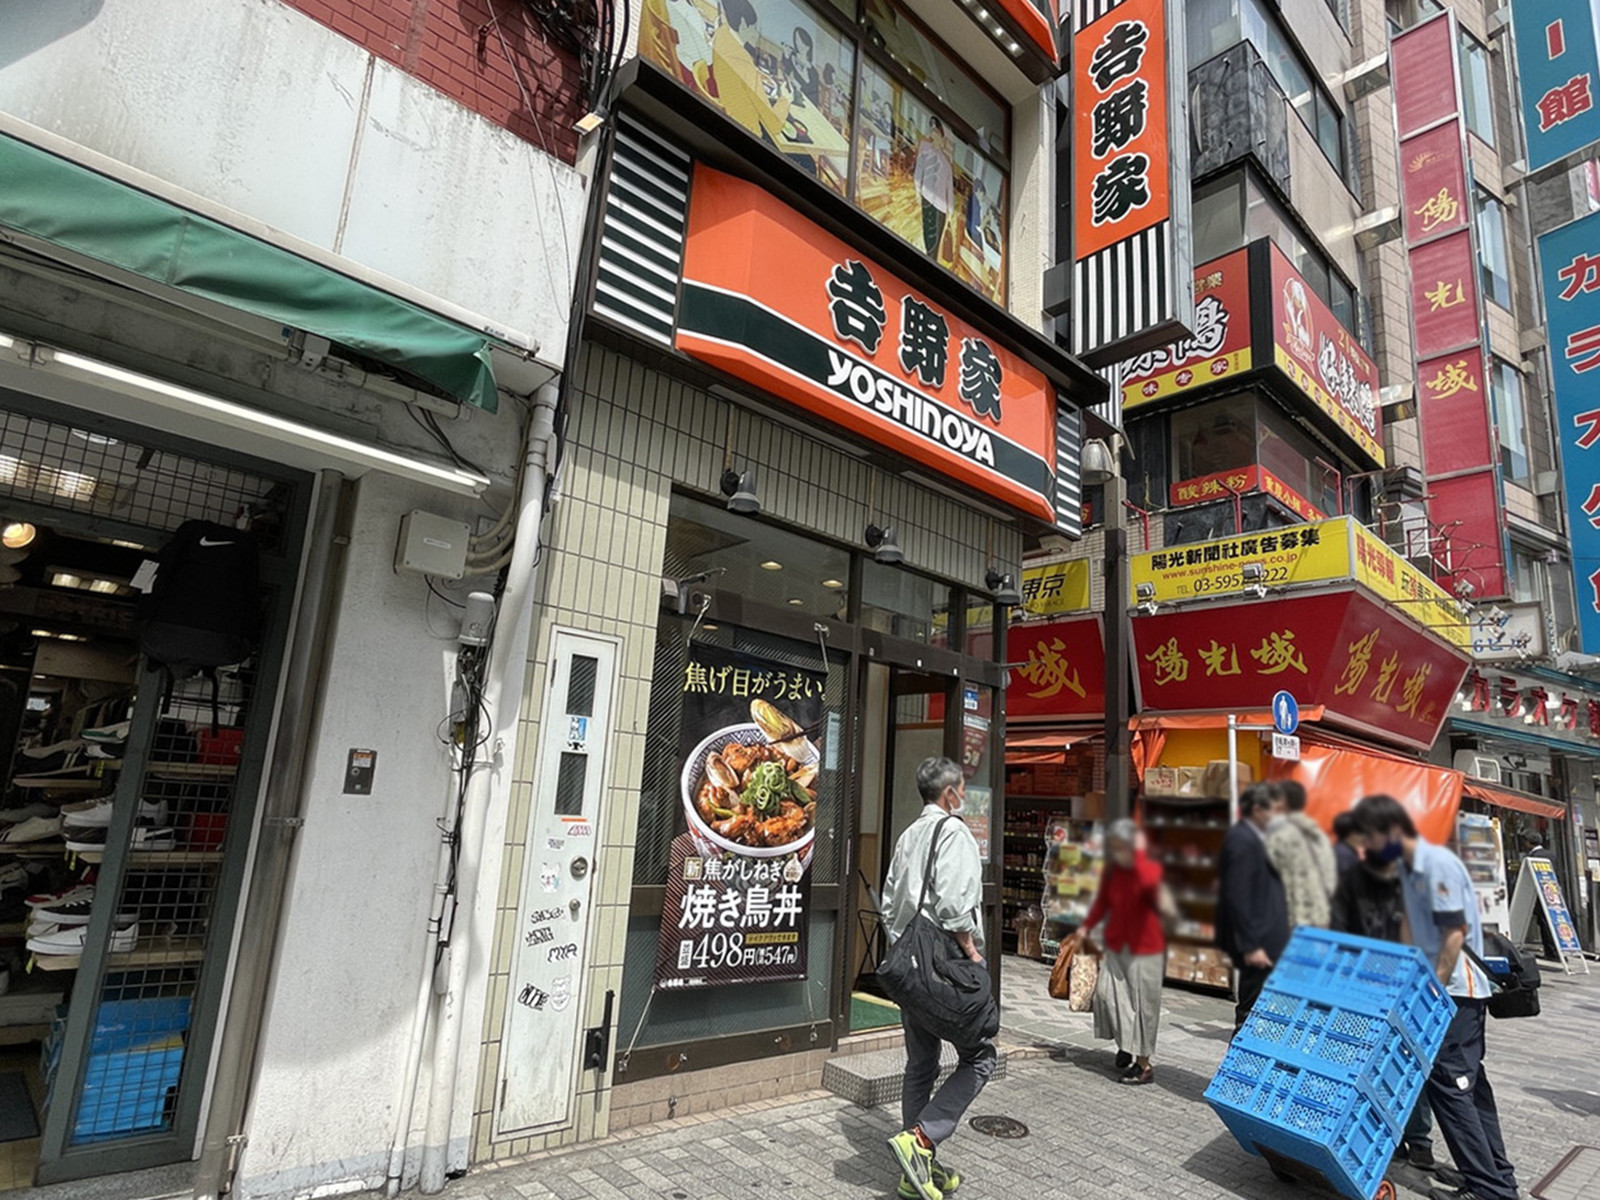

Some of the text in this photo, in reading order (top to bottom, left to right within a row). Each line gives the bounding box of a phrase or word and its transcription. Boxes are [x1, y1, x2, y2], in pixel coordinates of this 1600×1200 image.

[1088, 20, 1151, 227] 吉野家
[1414, 187, 1478, 400] 陽光城
[825, 259, 1003, 423] 吉野家
[827, 350, 995, 467] YOSHINOYA
[1177, 474, 1248, 501] 酸辣粉
[1193, 566, 1288, 592] 03-595222
[683, 660, 826, 701] 焦げ目がうまい。
[1145, 629, 1308, 686] 陽光城
[1334, 627, 1432, 719] 陽光城
[685, 860, 701, 878] 新
[702, 857, 785, 882] 焦がしねぎ
[678, 884, 803, 929] 焼き鳥丼
